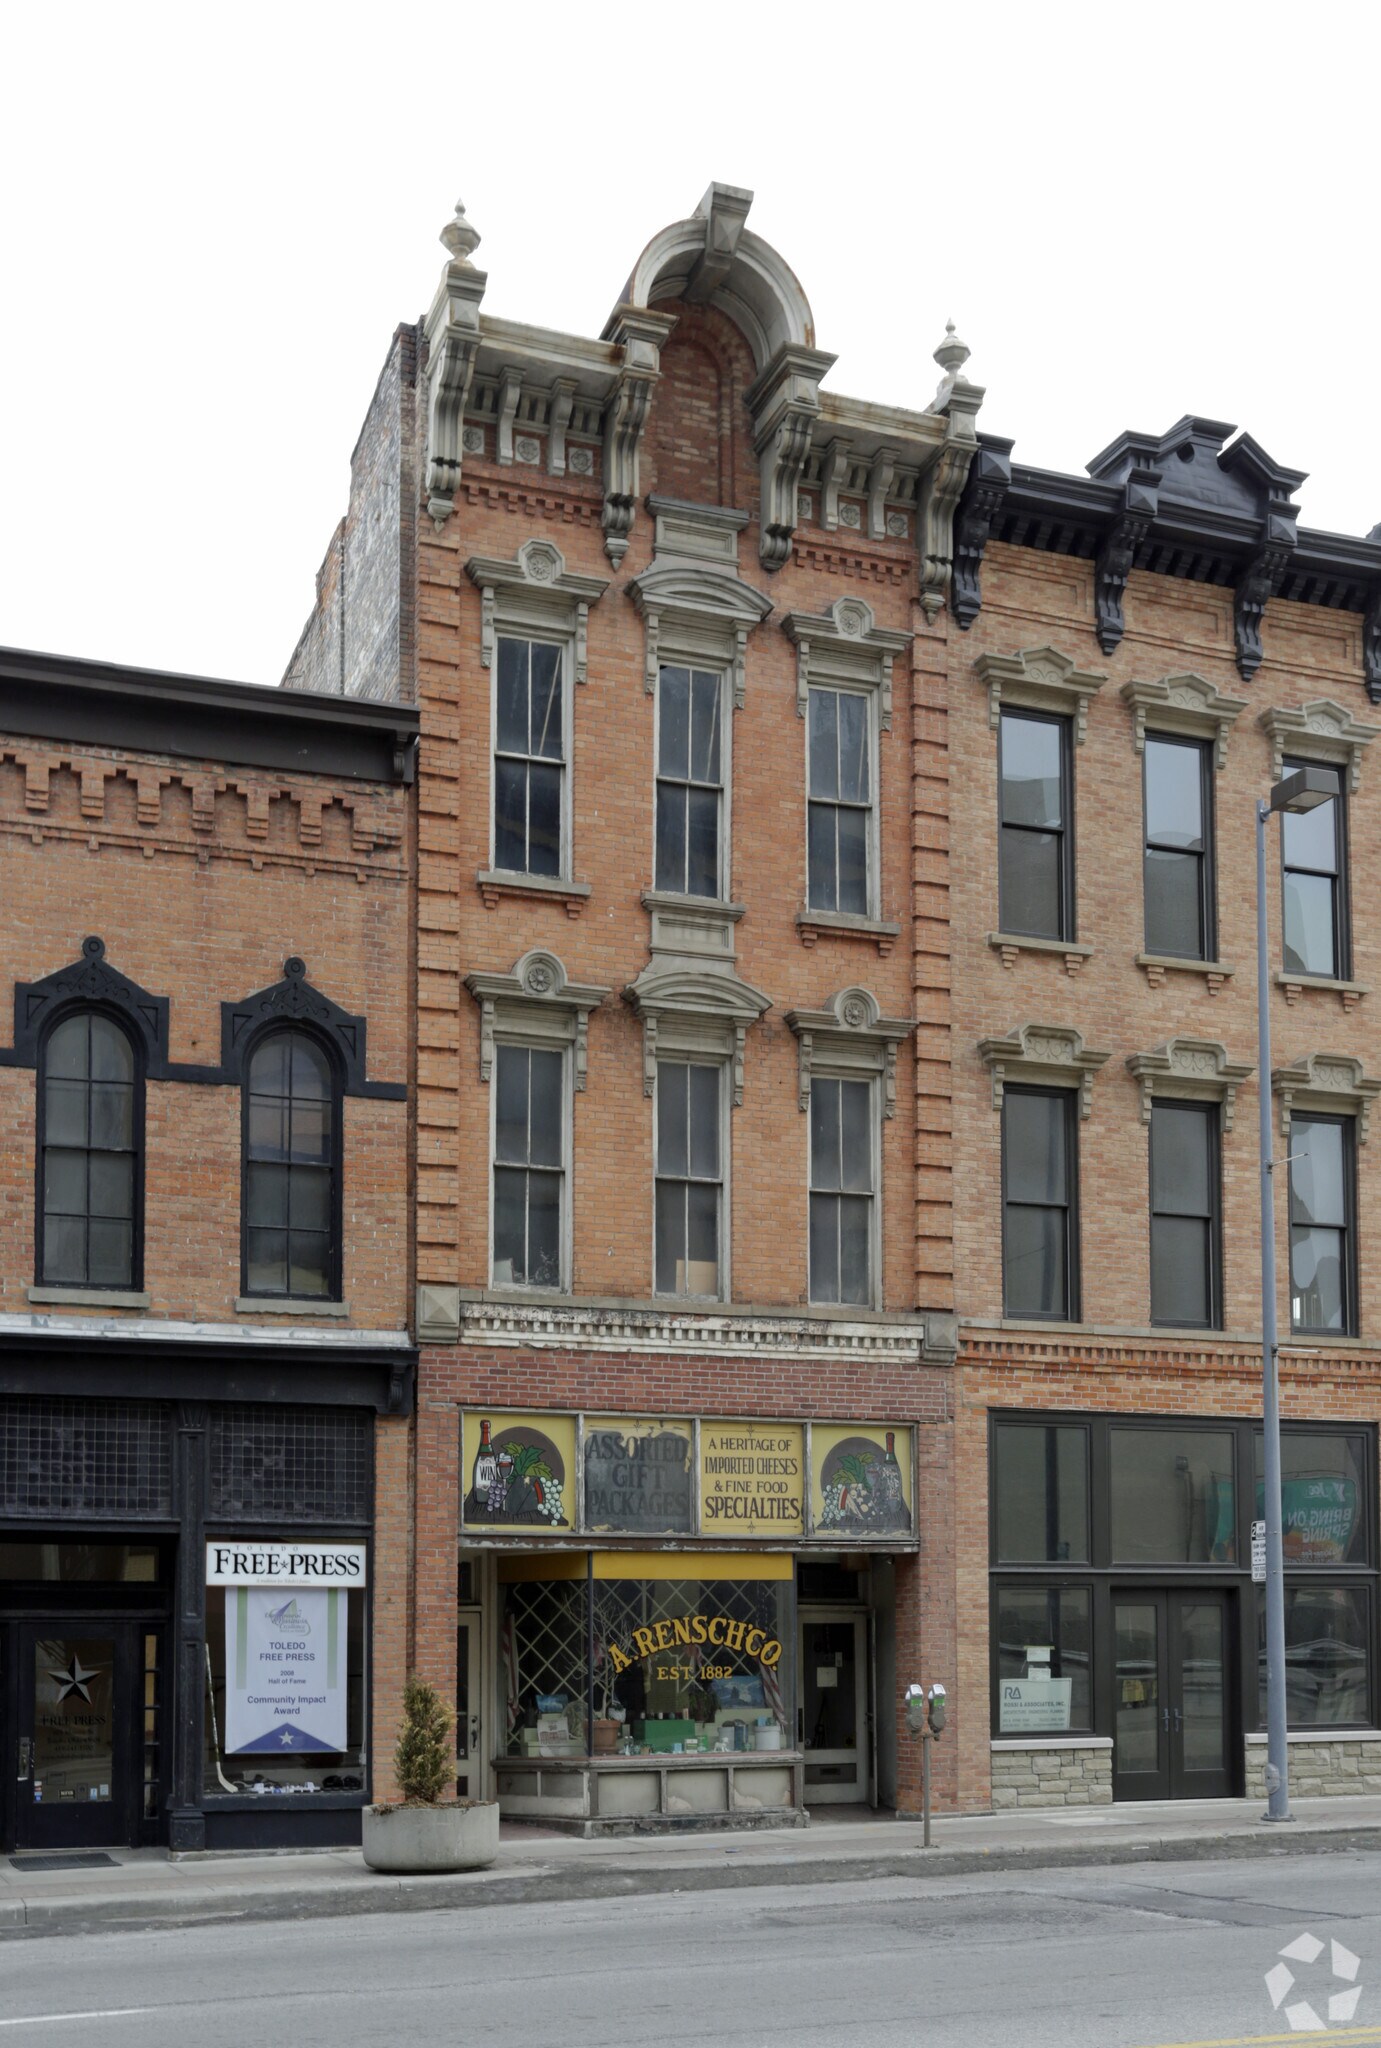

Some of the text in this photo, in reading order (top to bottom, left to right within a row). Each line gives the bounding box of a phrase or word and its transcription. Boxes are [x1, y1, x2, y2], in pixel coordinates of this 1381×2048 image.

[585, 1434, 689, 1462] ASSORTED
[708, 1438, 793, 1452] A HERITAGE OF
[705, 1456, 798, 1475] IMPORTED CHEESES
[612, 1463, 665, 1489] GIFT
[714, 1480, 788, 1494] & FINE FOOD
[588, 1488, 688, 1516] PACKAGES
[705, 1496, 800, 1520] SPECIALTIES
[213, 1549, 360, 1576] FREE PRESS
[269, 1641, 306, 1650] TOLEDO
[260, 1653, 315, 1661] FREE PRESS
[700, 1666, 733, 1680] 1882
[247, 1695, 326, 1705] Community Impact
[1004, 1686, 1022, 1700] RA
[273, 1707, 300, 1715] Award
[73, 1714, 106, 1726] PRESS
